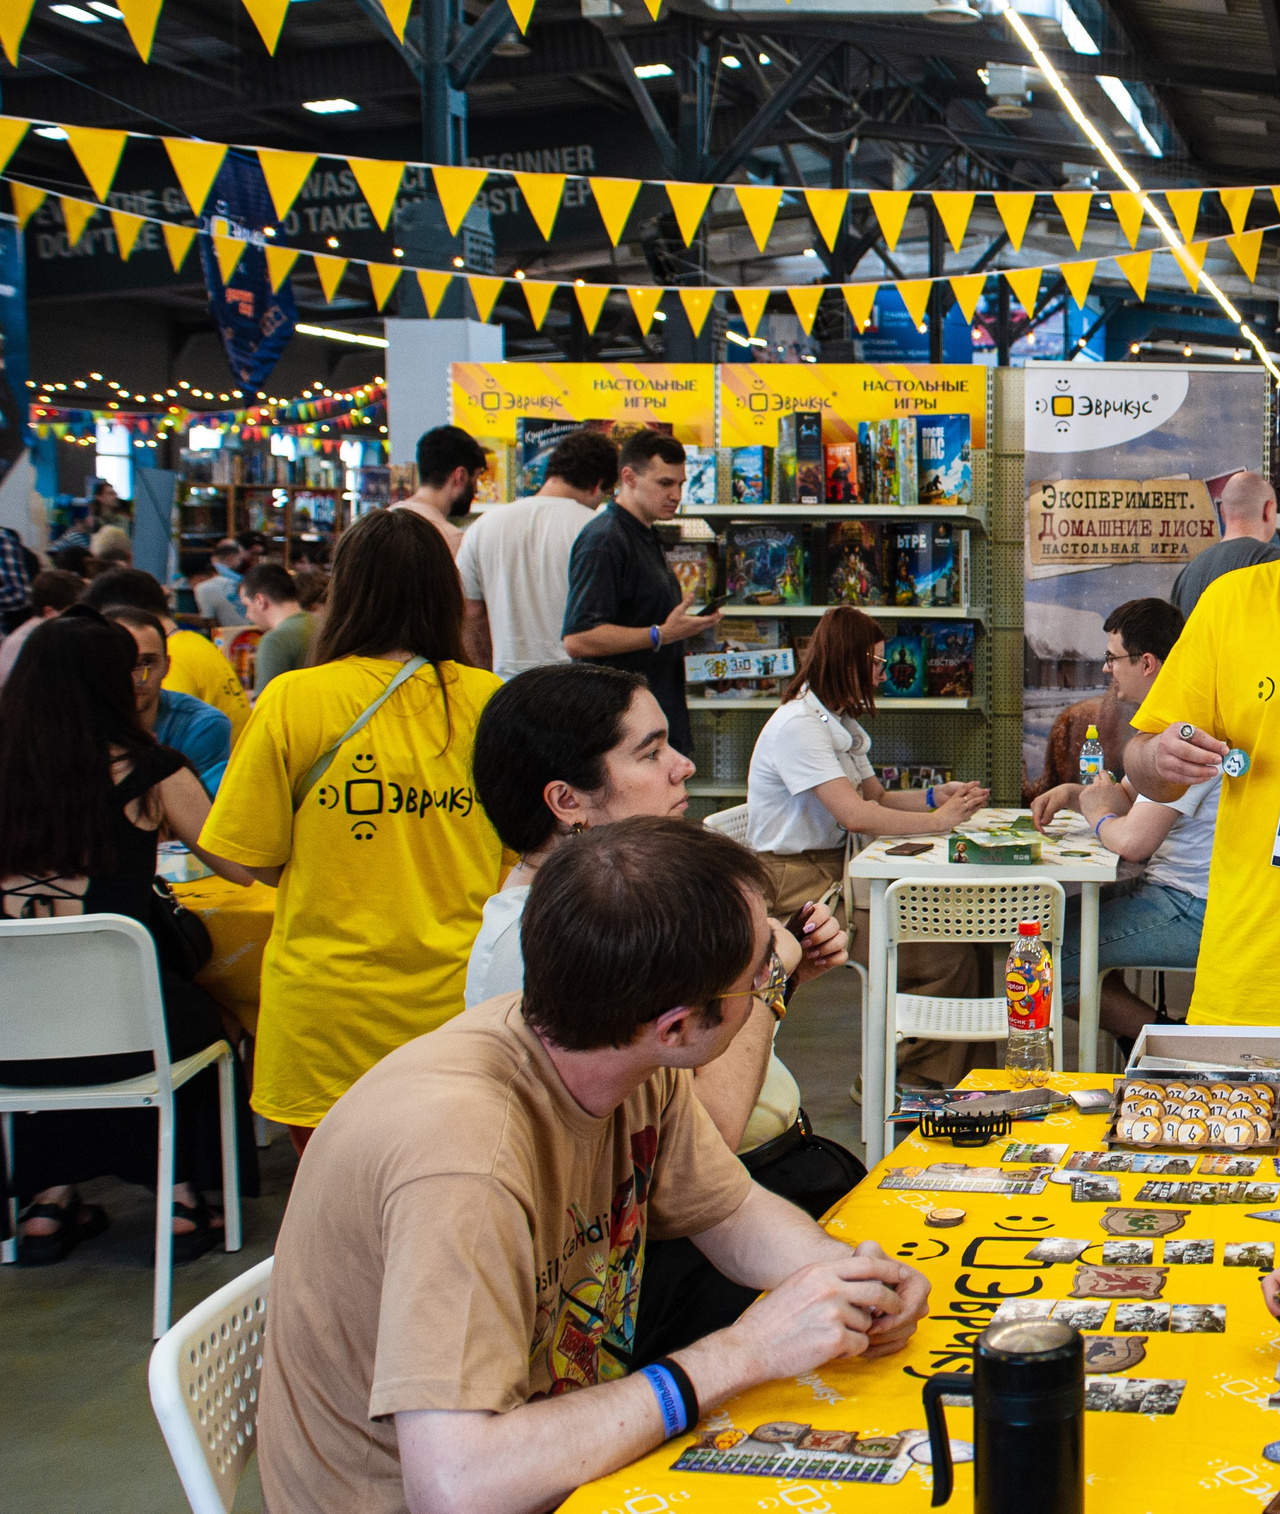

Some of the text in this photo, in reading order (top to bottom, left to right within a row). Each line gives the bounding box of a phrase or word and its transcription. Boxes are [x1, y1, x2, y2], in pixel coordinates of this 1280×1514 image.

[304, 202, 373, 233] TAKE
[593, 378, 698, 391] НАСТОЛЬНЫЕ
[862, 379, 969, 393] НАСТОЛЬНЫЕ
[623, 397, 667, 409] ИГРЫ
[894, 398, 937, 410] ИГРЫ
[921, 437, 945, 460] НАС
[1041, 542, 1189, 555] НАСТОЛЬНАЯ ИГРА
[388, 782, 474, 819] Эврику
[1143, 1124, 1150, 1139] 5
[1166, 1124, 1174, 1138] 9
[1188, 1127, 1196, 1141] 6
[1208, 1123, 1222, 1138] 10
[1234, 1126, 1241, 1143] 7
